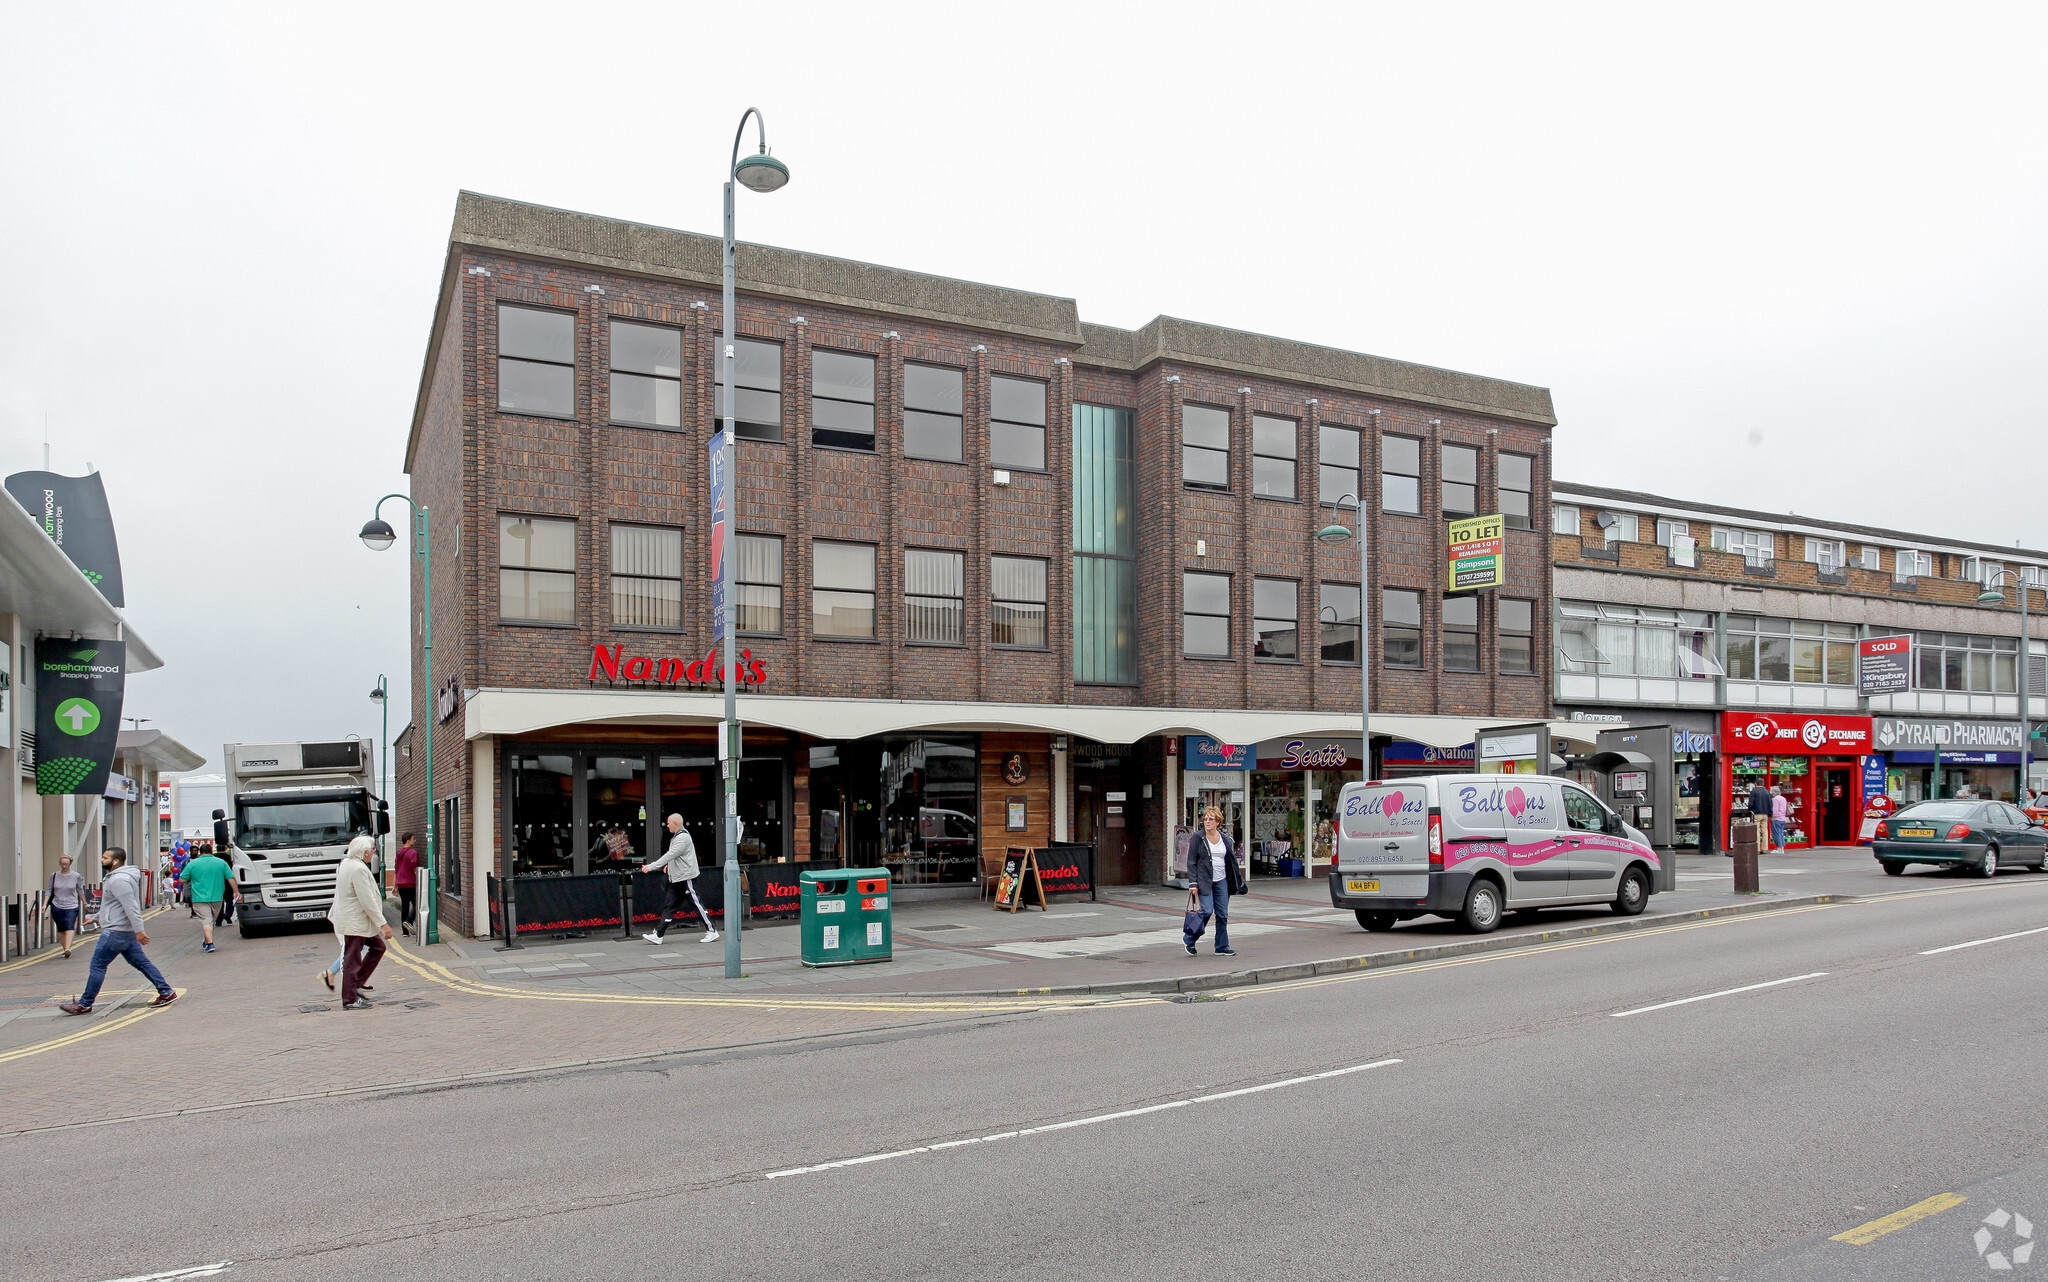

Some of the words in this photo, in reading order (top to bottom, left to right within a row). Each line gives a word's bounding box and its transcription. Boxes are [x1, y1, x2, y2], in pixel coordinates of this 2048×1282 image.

[1482, 517, 1501, 525] OFFICES
[1452, 529, 1471, 543] TO
[1476, 525, 1500, 539] LET
[1458, 548, 1491, 558] REMAINING
[1457, 559, 1494, 569] Stimpsons
[1872, 643, 1897, 651] SOLD
[43, 662, 119, 673] borehamwood
[587, 643, 767, 685] Nando's
[60, 672, 89, 680] Shopping
[1867, 672, 1907, 681] Kingsbury
[1828, 730, 1866, 740] EXCHANGE
[1896, 721, 1951, 745] PYRAMD
[1954, 722, 2015, 746] PHARMACY
[1105, 744, 1133, 757] HOUSE
[1281, 740, 1348, 769] Scotts
[1437, 747, 1475, 759] Nation
[1389, 818, 1399, 827] By
[1401, 817, 1423, 826] Scotts
[1517, 815, 1526, 826] By
[1529, 815, 1549, 823] Scotts
[288, 851, 324, 859] SCANIA
[1455, 846, 1469, 860] 020
[1038, 864, 1079, 879] ando's
